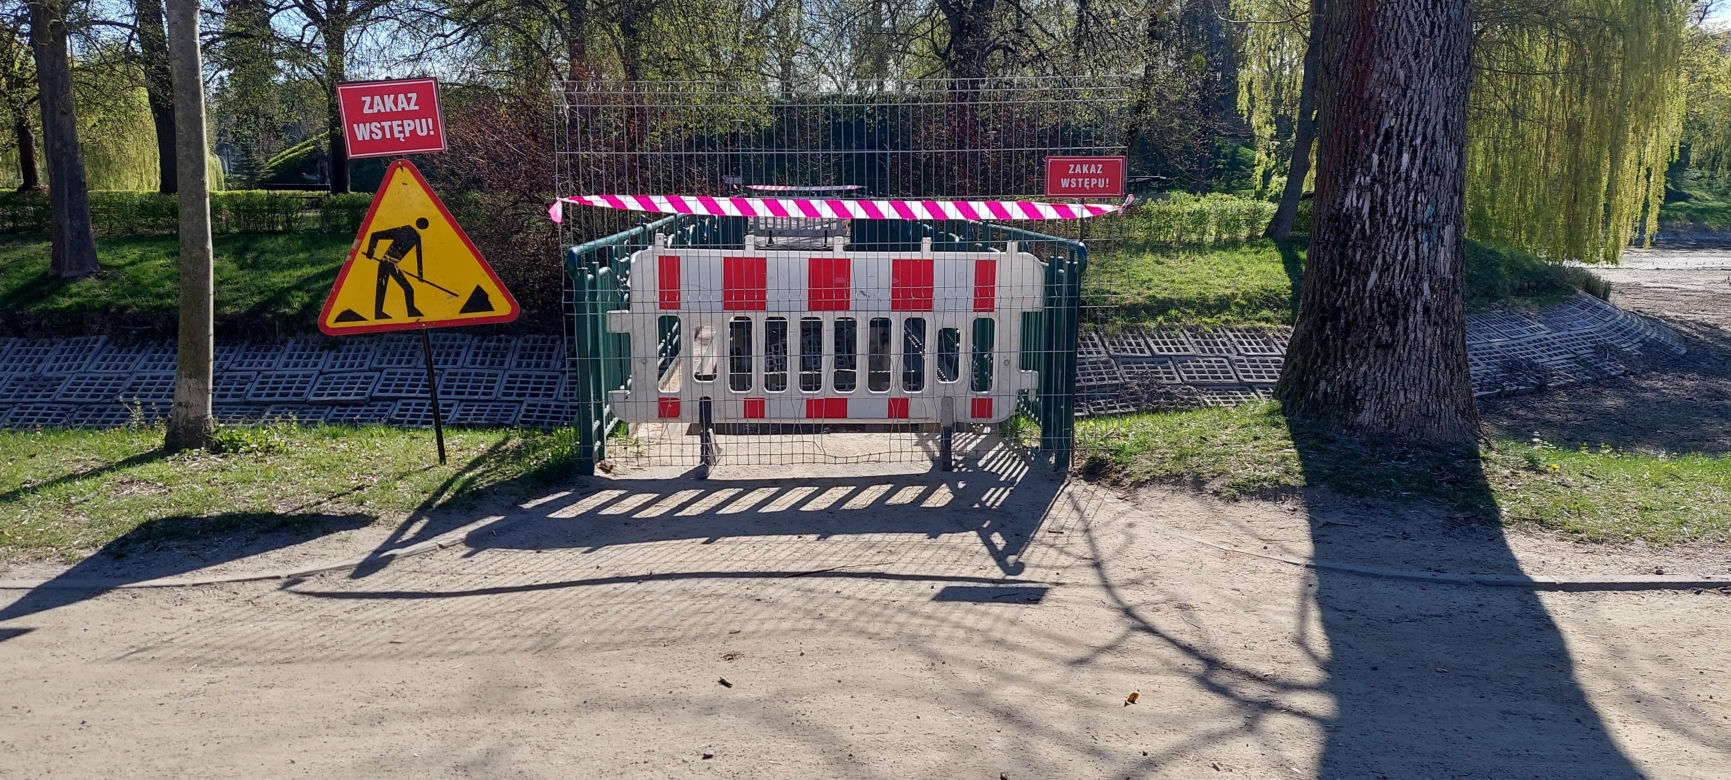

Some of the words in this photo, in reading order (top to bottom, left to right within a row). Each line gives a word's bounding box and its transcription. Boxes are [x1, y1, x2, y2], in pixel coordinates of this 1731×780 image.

[361, 93, 419, 114] ZAKAZ
[353, 118, 434, 142] WSTĘPU!
[1068, 164, 1103, 174] ZAKAZ
[1060, 178, 1109, 190] WSTĘPU!
